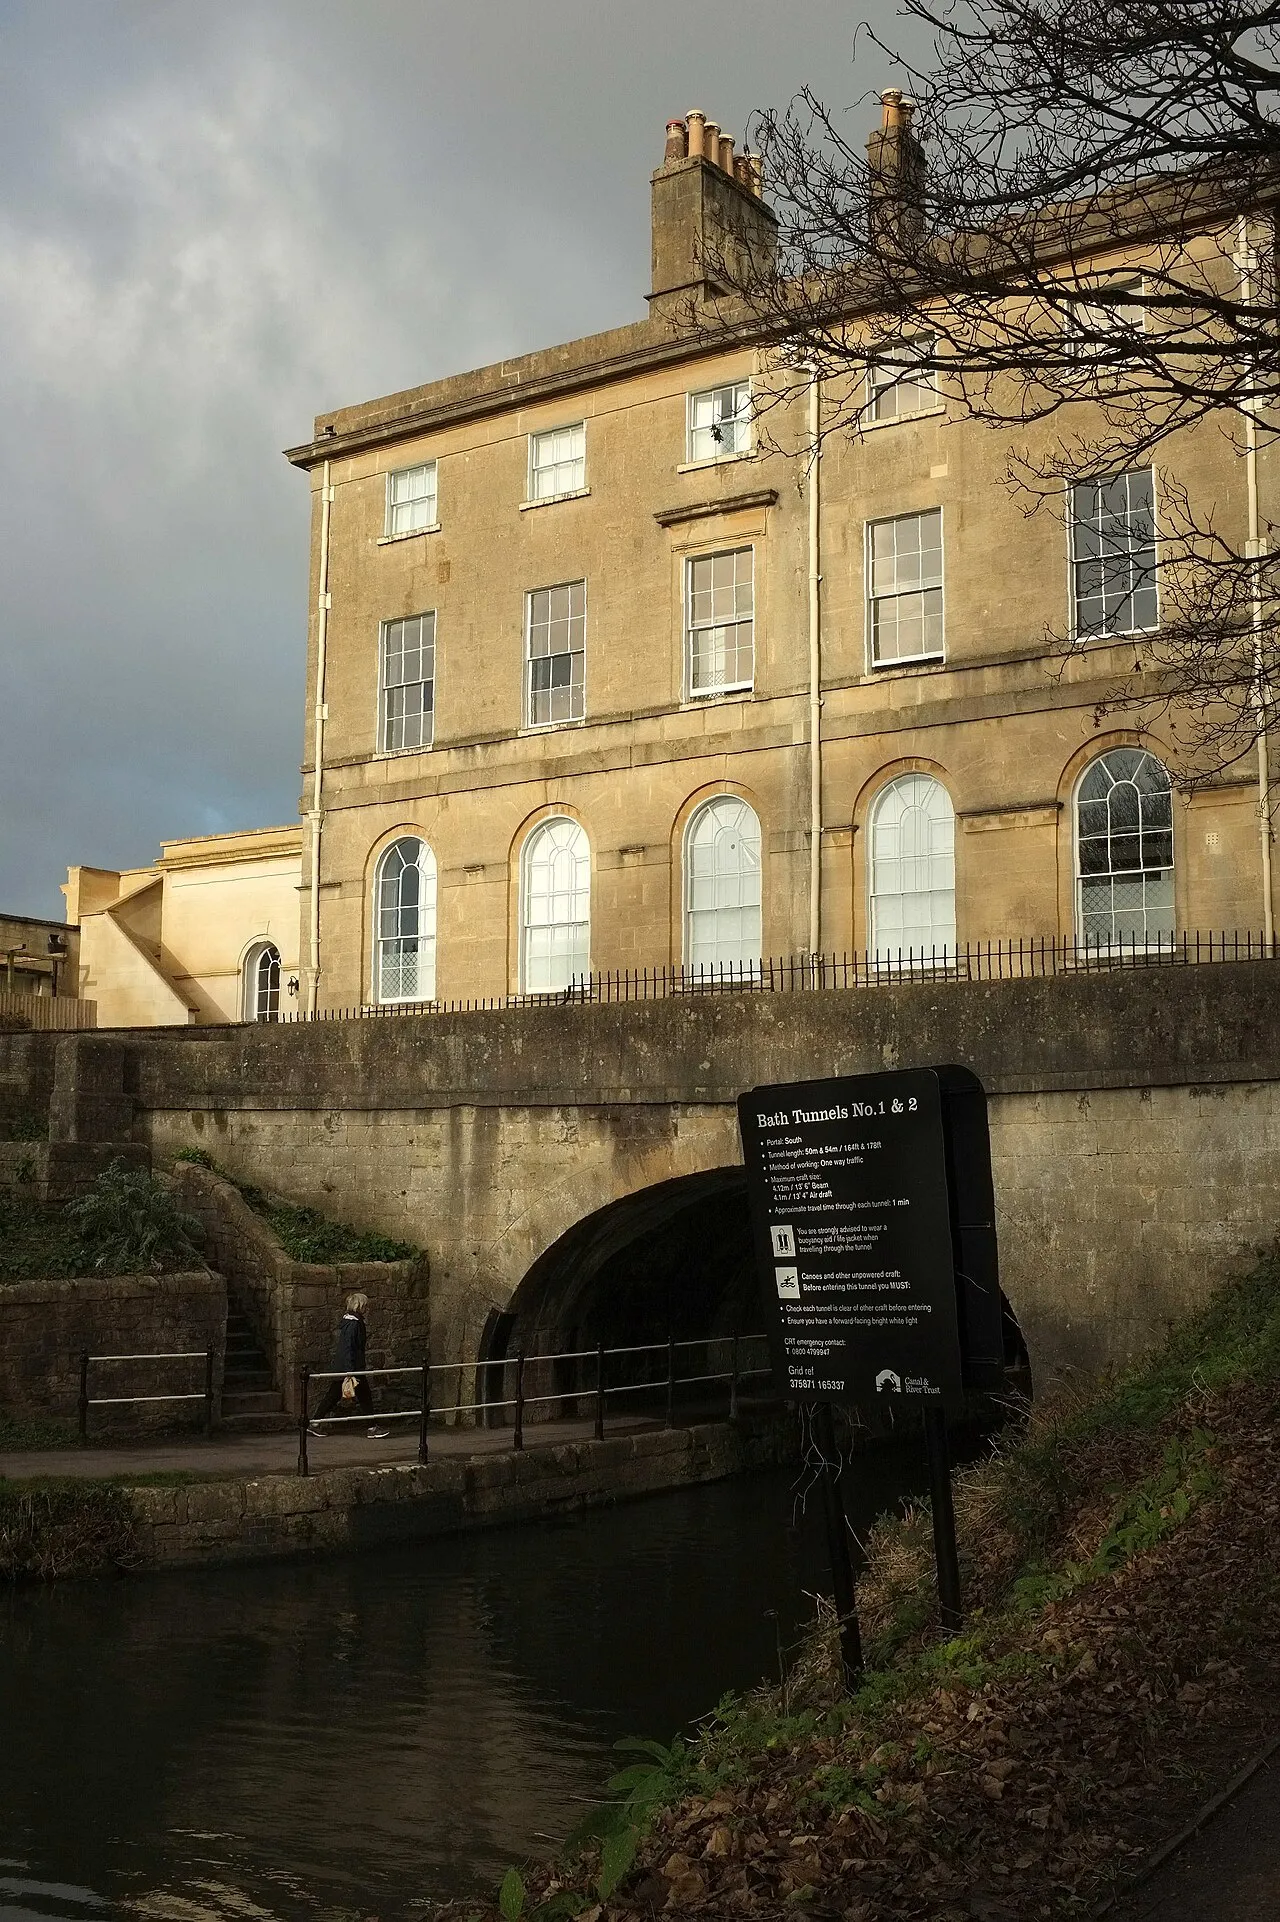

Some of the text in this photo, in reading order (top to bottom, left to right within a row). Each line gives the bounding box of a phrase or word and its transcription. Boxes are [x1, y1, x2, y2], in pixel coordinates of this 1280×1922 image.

[757, 1112, 789, 1128] Bath
[792, 1105, 848, 1124] Tunnels
[852, 1101, 886, 1117] No.1
[908, 1097, 918, 1111] 2
[784, 1136, 803, 1144] South
[768, 1150, 785, 1158] Tunnel
[805, 1147, 818, 1155] 50m
[825, 1145, 838, 1153] 54m
[769, 1162, 790, 1171] Method
[820, 1159, 833, 1167] One
[833, 1159, 846, 1167] way
[846, 1156, 864, 1165] traffic
[770, 1175, 795, 1183] Maximum
[796, 1173, 809, 1182] craft
[811, 1181, 829, 1190] Beam
[818, 1189, 833, 1198] draft
[774, 1205, 807, 1215] Approximate
[807, 1204, 822, 1212] travel
[822, 1203, 835, 1211] time
[835, 1201, 856, 1211] through
[857, 1200, 870, 1209] each
[897, 1198, 910, 1206] min
[818, 1226, 839, 1236] strongly
[839, 1225, 860, 1233] advised
[798, 1236, 823, 1245] buoyancy
[823, 1235, 833, 1243] aid
[845, 1234, 863, 1243] jacket
[799, 1243, 872, 1254] travelling through the tunnel
[801, 1272, 823, 1280] Canoes
[835, 1271, 850, 1279] other
[851, 1270, 885, 1280] unpowered
[802, 1283, 822, 1291] Before
[822, 1283, 846, 1292] entering
[858, 1282, 877, 1290] tunnel
[878, 1283, 890, 1292] you
[890, 1281, 911, 1290] MUST:
[785, 1304, 802, 1312] Check
[802, 1304, 816, 1312] each
[816, 1304, 832, 1312] tunnel
[838, 1304, 852, 1312] clear
[874, 1303, 888, 1311] craft
[888, 1303, 907, 1311] before
[907, 1303, 931, 1313] entering
[787, 1316, 805, 1325] Ensure
[805, 1318, 815, 1326] you
[815, 1317, 828, 1325] have
[871, 1316, 888, 1327] bright
[888, 1317, 905, 1325] white
[905, 1316, 918, 1326] light
[784, 1337, 796, 1345] CRT
[796, 1339, 824, 1348] emergency
[788, 1365, 814, 1375] Grid ref
[789, 1379, 845, 1390] 375871 165337
[904, 1376, 923, 1385] Canal
[905, 1385, 941, 1394] River Trust
